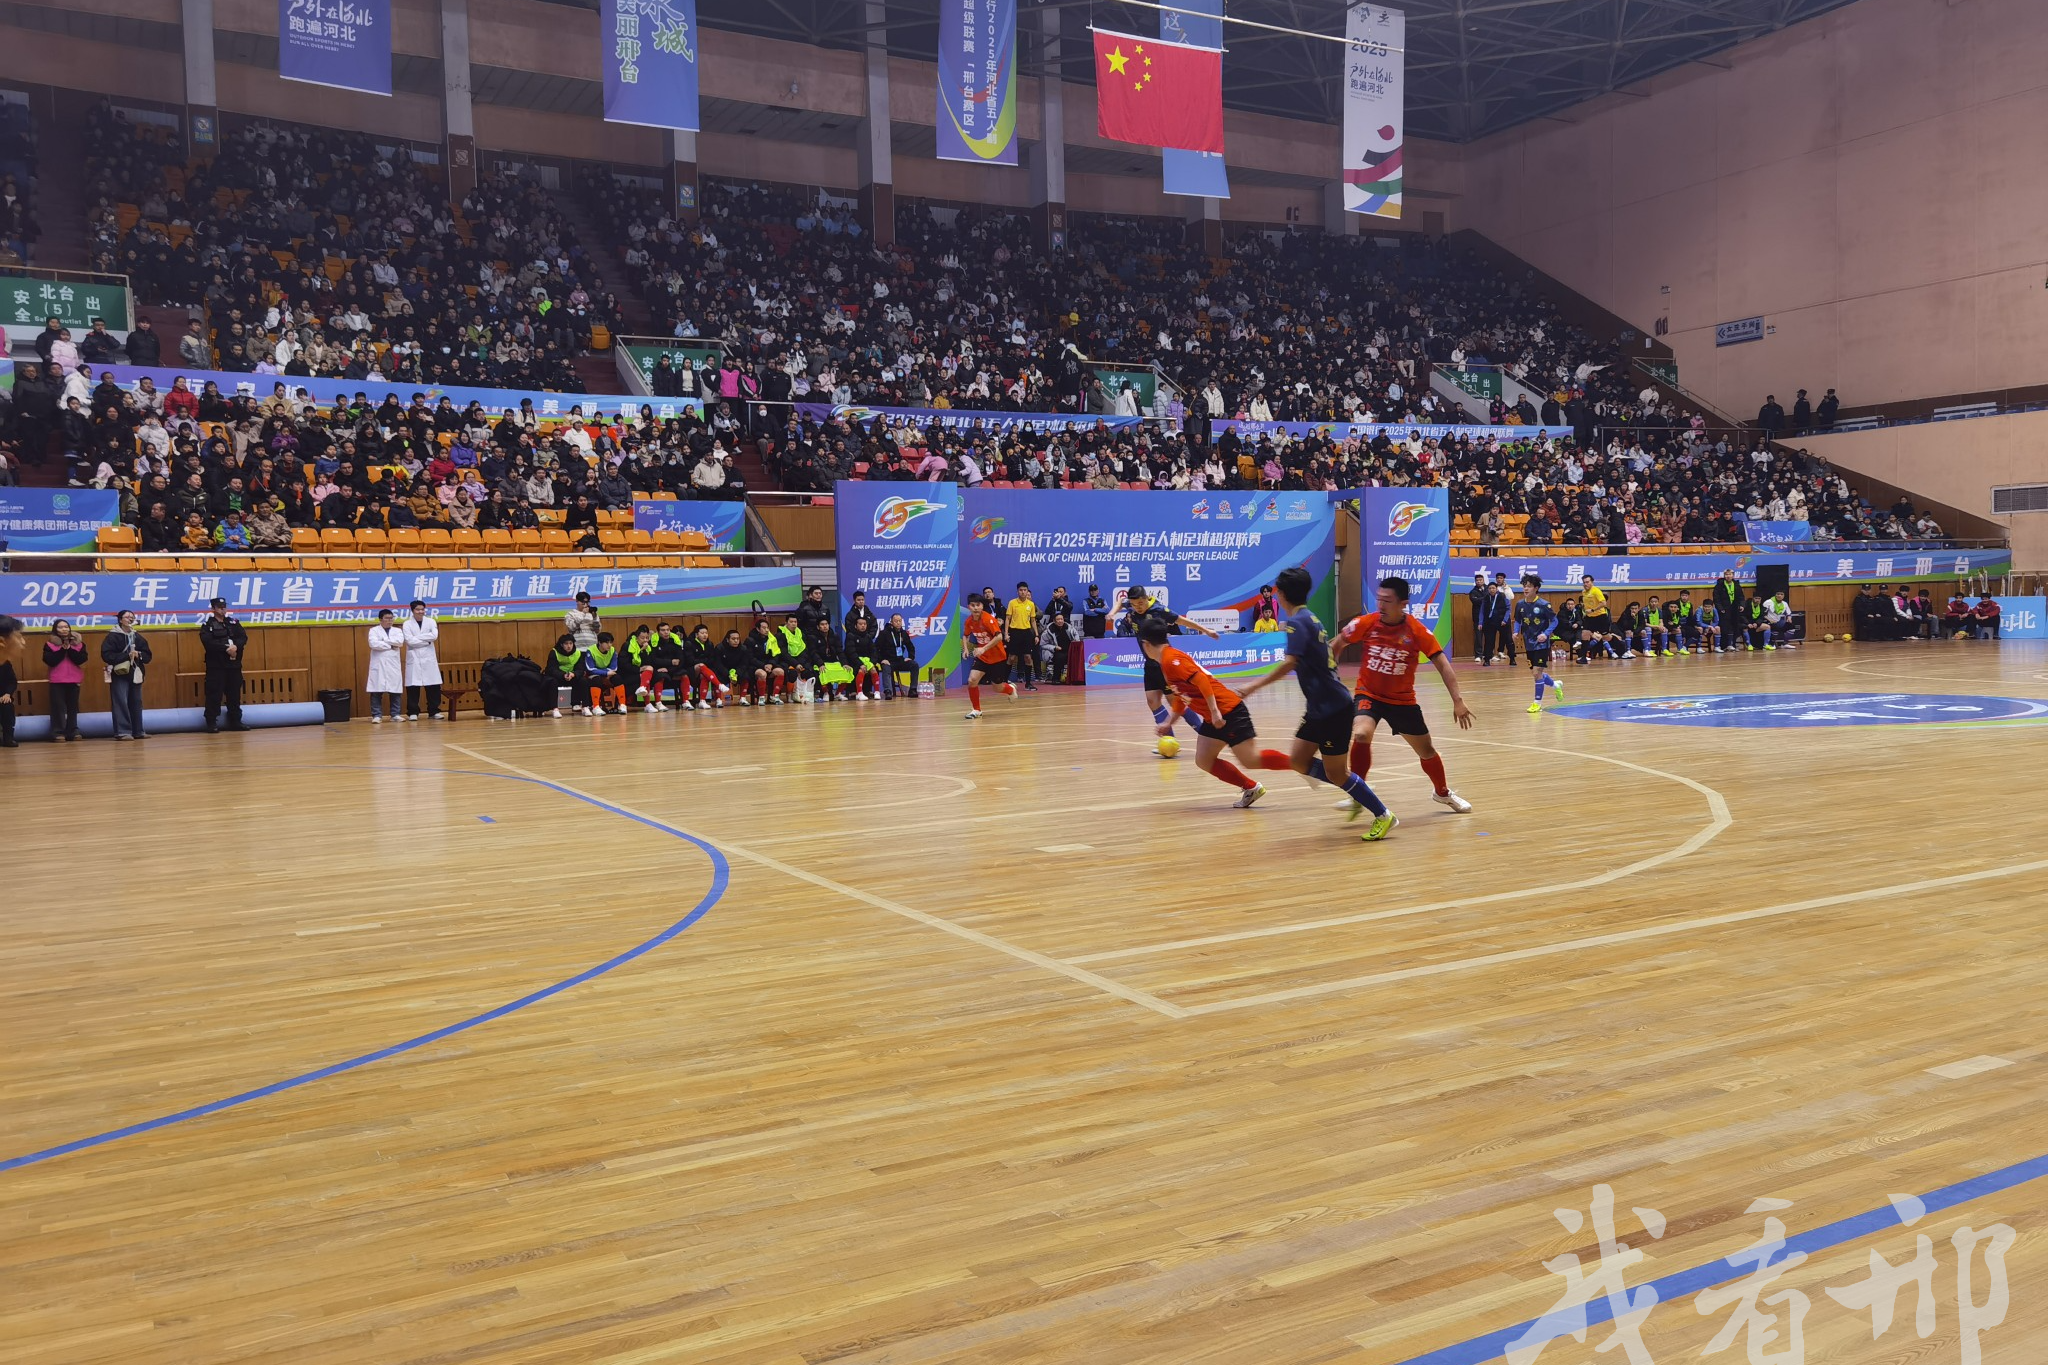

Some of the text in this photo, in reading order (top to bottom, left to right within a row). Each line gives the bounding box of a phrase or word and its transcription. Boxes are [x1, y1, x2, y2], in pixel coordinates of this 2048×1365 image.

[289, 15, 357, 42] 跑遍河北
[963, 0, 975, 54] 超级联赛
[1351, 37, 1388, 57] 2025
[1350, 78, 1384, 95] 跑遍河北
[39, 283, 75, 302] 北台
[13, 289, 31, 323] 安全
[1461, 372, 1479, 384] 北台
[1482, 378, 1491, 399] 出口
[542, 398, 675, 418] 美丽邢台
[992, 530, 1262, 551] 中国银行2025年河北省五人制足球超级联赛
[860, 559, 947, 573] 中国银行2025年
[1019, 551, 1239, 563] BANK OF CHINA 2025 HEBEI FUTSAL SUPER LEAGUE
[1379, 554, 1440, 566] 中国银行2025年
[1078, 563, 1202, 584] 邢台赛区
[1836, 556, 1970, 579] 美丽邢台
[856, 575, 950, 592] 河北省五人制足球
[875, 594, 924, 609] 超级联赛
[21, 616, 58, 628] ANK
[75, 614, 104, 628] OF
[134, 613, 180, 626] HINA
[250, 610, 300, 624] HEBEI
[316, 609, 375, 623] FUTSAL
[392, 608, 440, 620] SUR
[453, 605, 507, 618] LEAGUE
[1116, 653, 1146, 663] 中国银行
